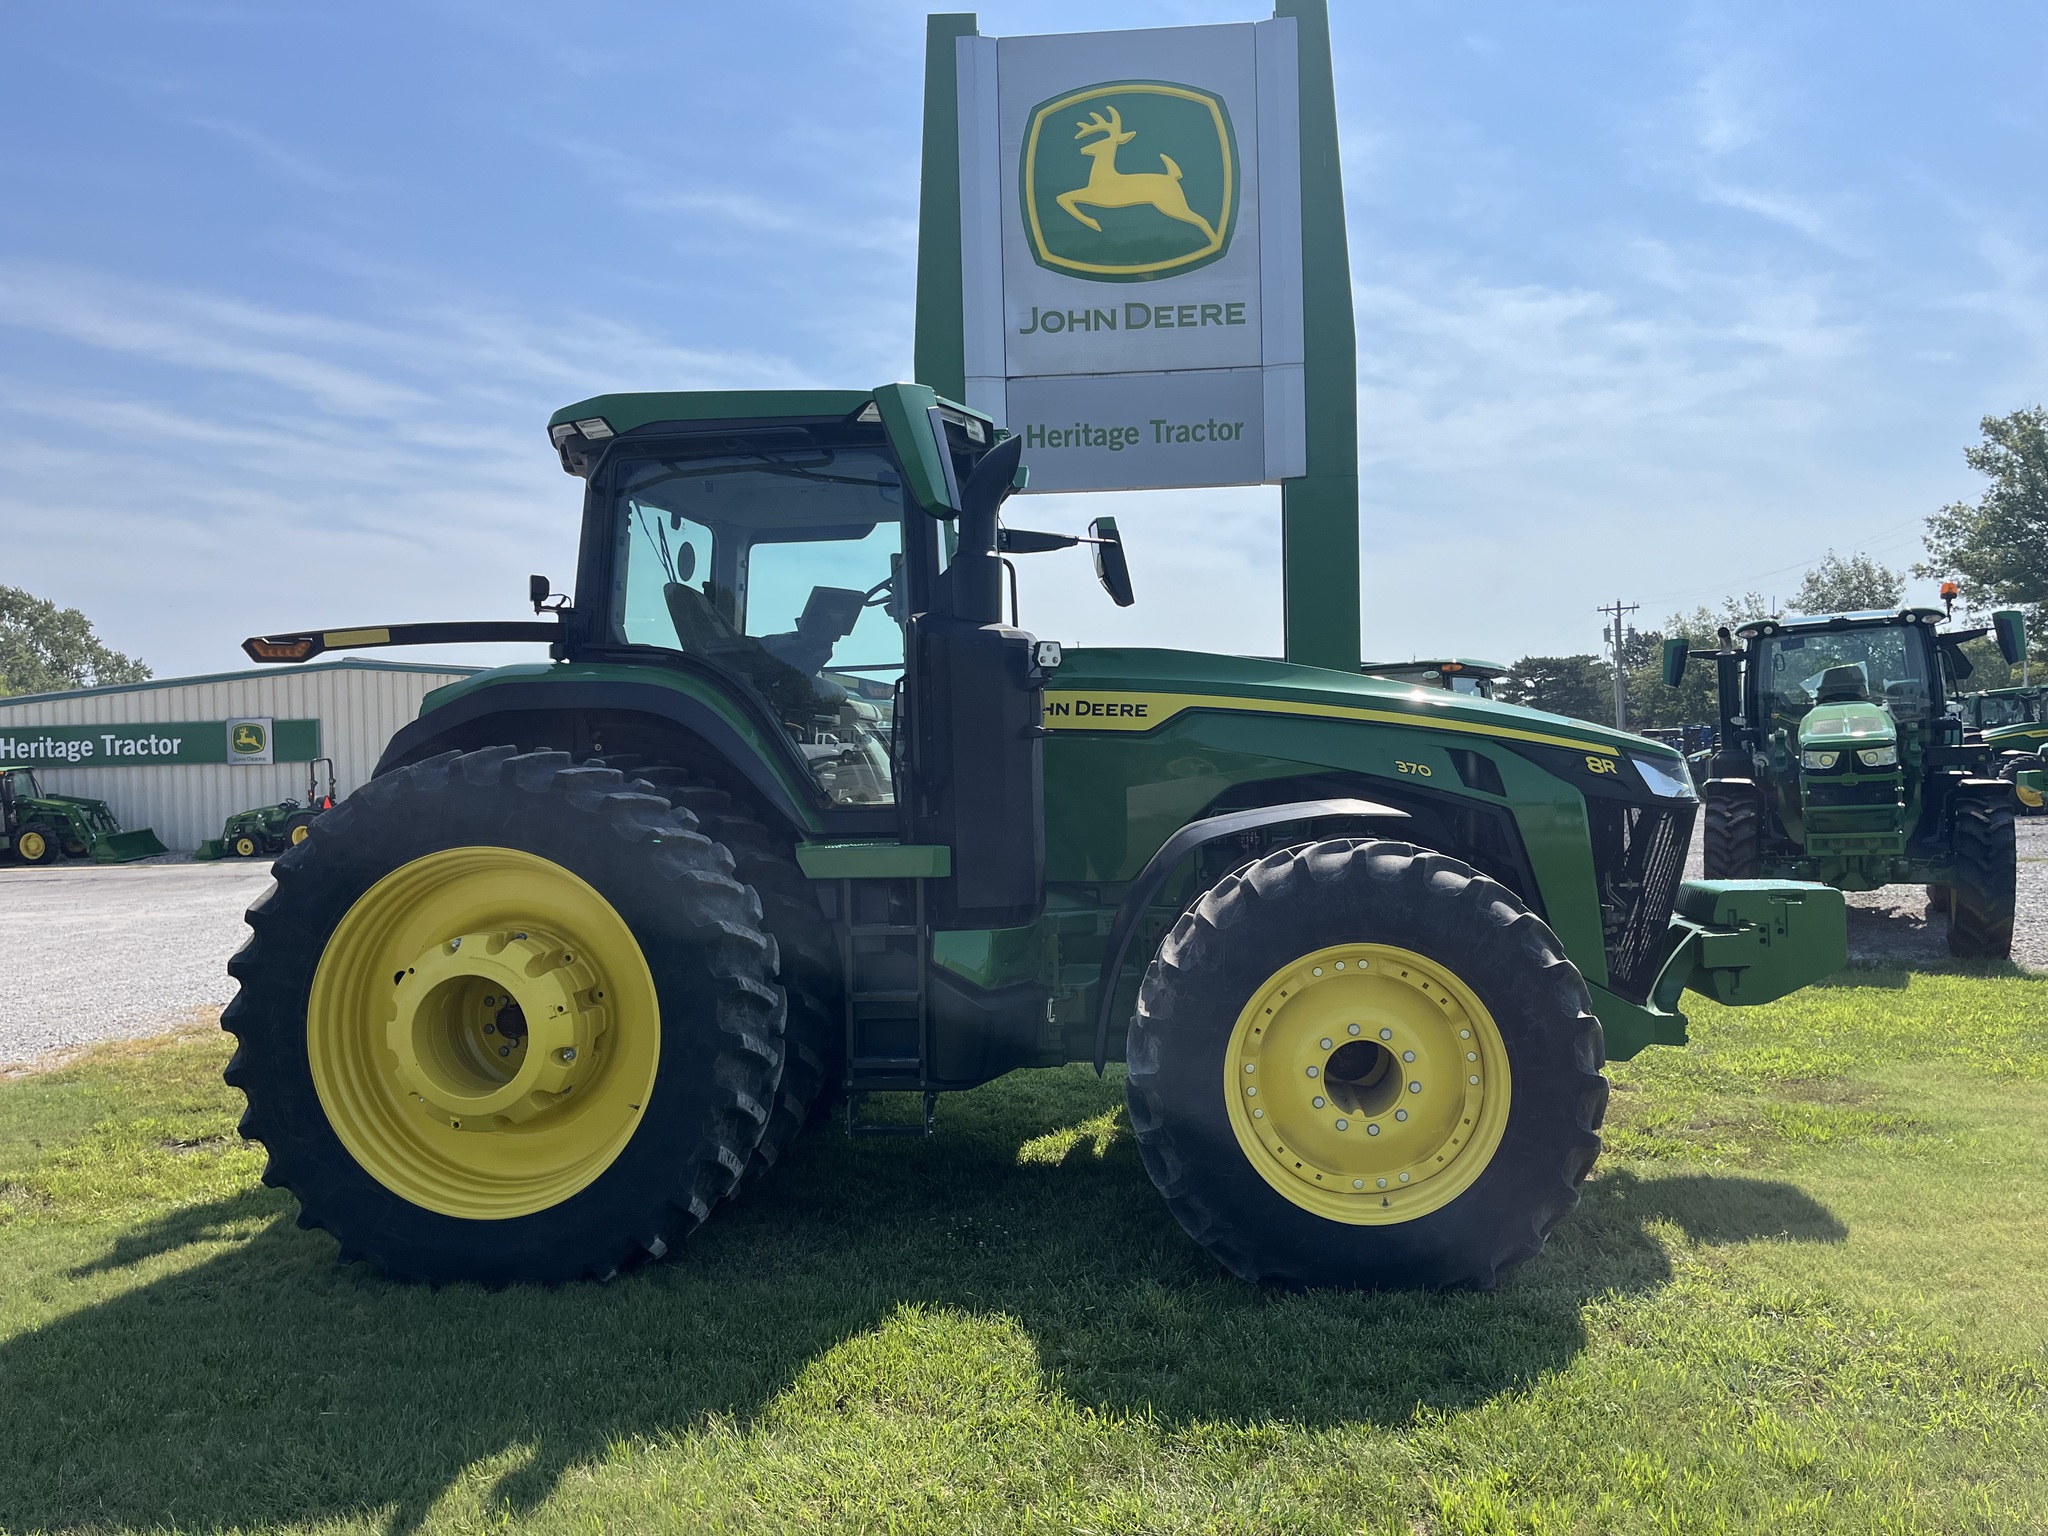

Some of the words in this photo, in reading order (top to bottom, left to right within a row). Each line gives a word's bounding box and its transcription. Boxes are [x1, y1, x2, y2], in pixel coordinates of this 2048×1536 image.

[1019, 306, 1117, 334] JOHN
[1125, 302, 1246, 330] DEERE
[1026, 422, 1139, 451] Heritage
[1150, 418, 1244, 444] Tractor
[1045, 703, 1070, 716] HN
[1075, 700, 1148, 717] DEERE
[0, 736, 94, 762] Heritage
[100, 734, 182, 756] Tractor
[1394, 760, 1432, 777] 370
[1585, 756, 1617, 774] 8R
